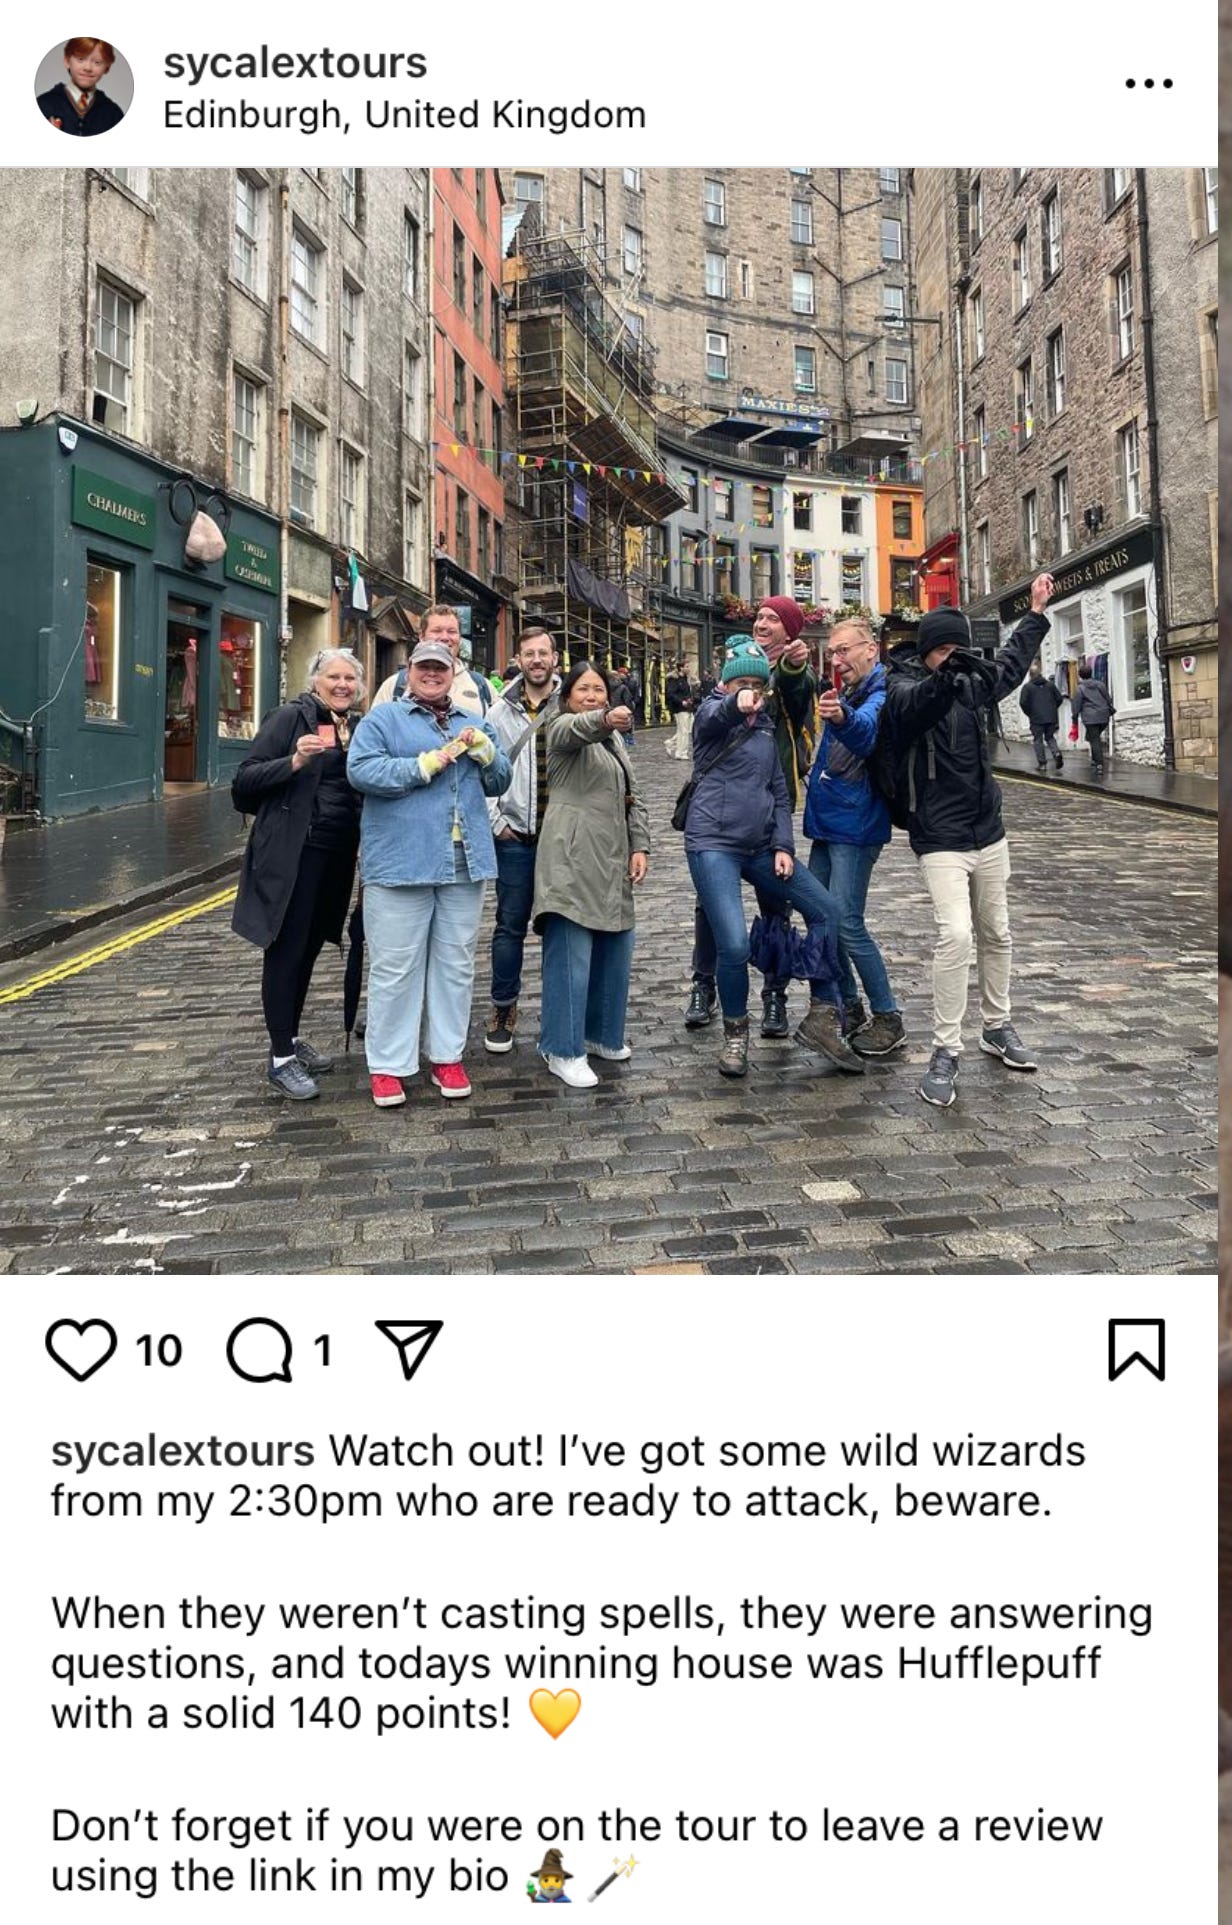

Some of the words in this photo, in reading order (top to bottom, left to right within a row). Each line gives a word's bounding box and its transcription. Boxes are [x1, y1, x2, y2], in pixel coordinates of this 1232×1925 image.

[87, 492, 146, 526] CHALMERS
[1084, 566, 1093, 581] &
[1094, 547, 1129, 577] TREATS
